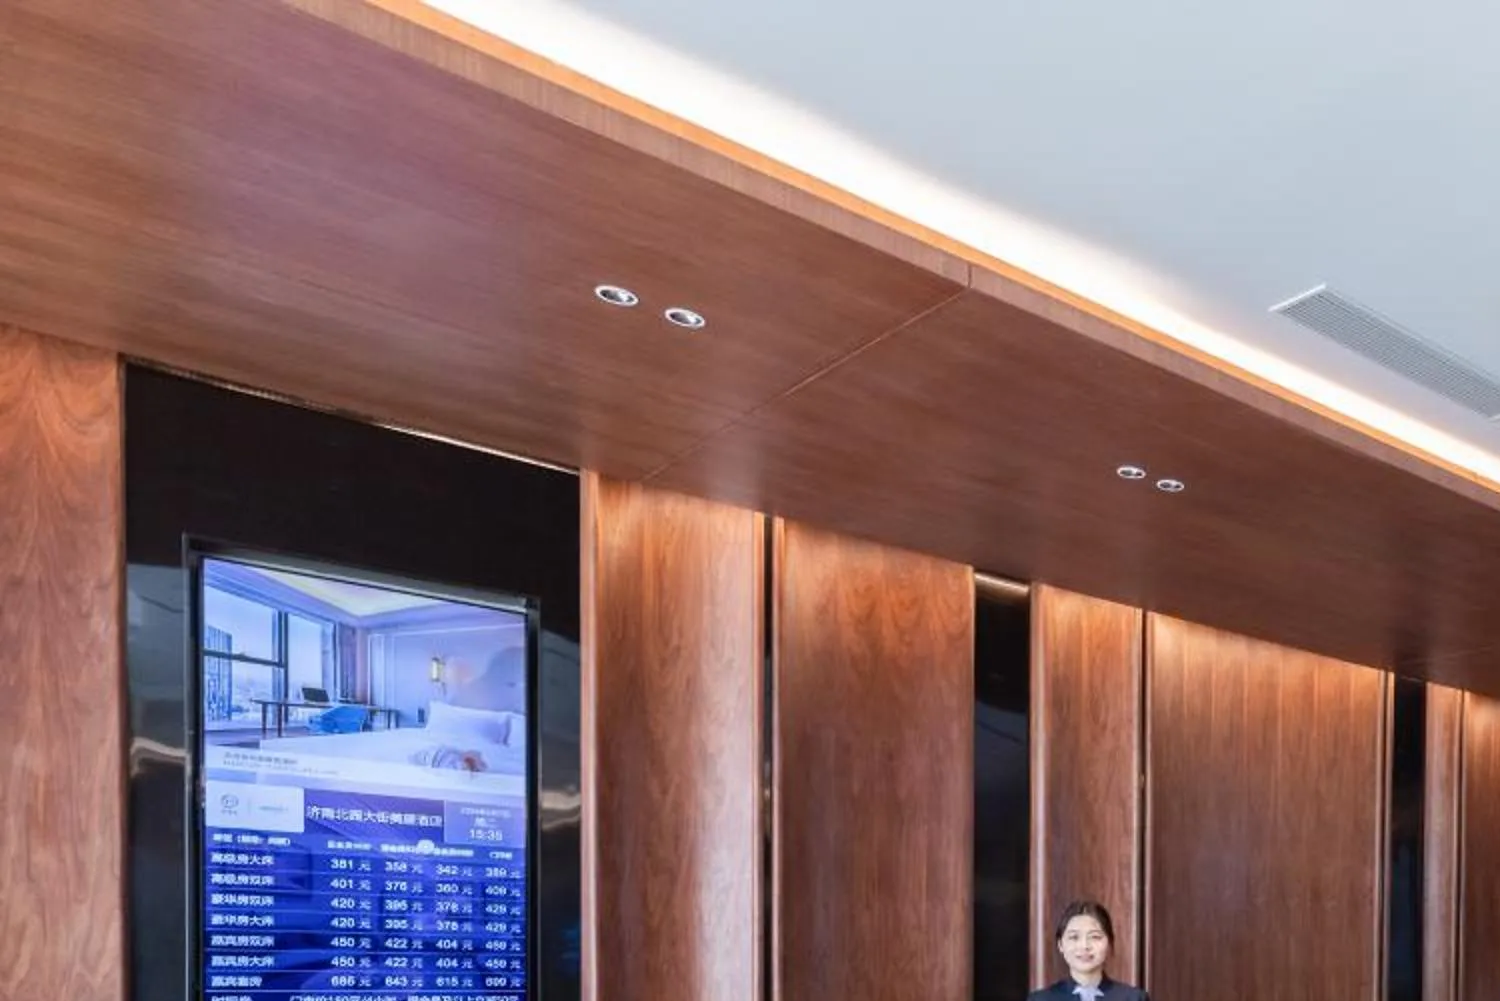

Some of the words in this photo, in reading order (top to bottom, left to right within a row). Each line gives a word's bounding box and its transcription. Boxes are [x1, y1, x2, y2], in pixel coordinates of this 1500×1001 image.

[306, 806, 444, 828] 济南北园大街美居酒店
[331, 859, 353, 870] 381
[436, 865, 459, 876] 342
[330, 879, 354, 890] 401
[330, 898, 355, 910] 420
[331, 918, 355, 929] 420
[330, 938, 355, 948] 450
[385, 938, 408, 950] 422
[436, 940, 458, 950] 404
[331, 957, 355, 968] 450
[384, 958, 408, 969] 422
[436, 958, 459, 970] 404
[435, 977, 459, 988] 615
